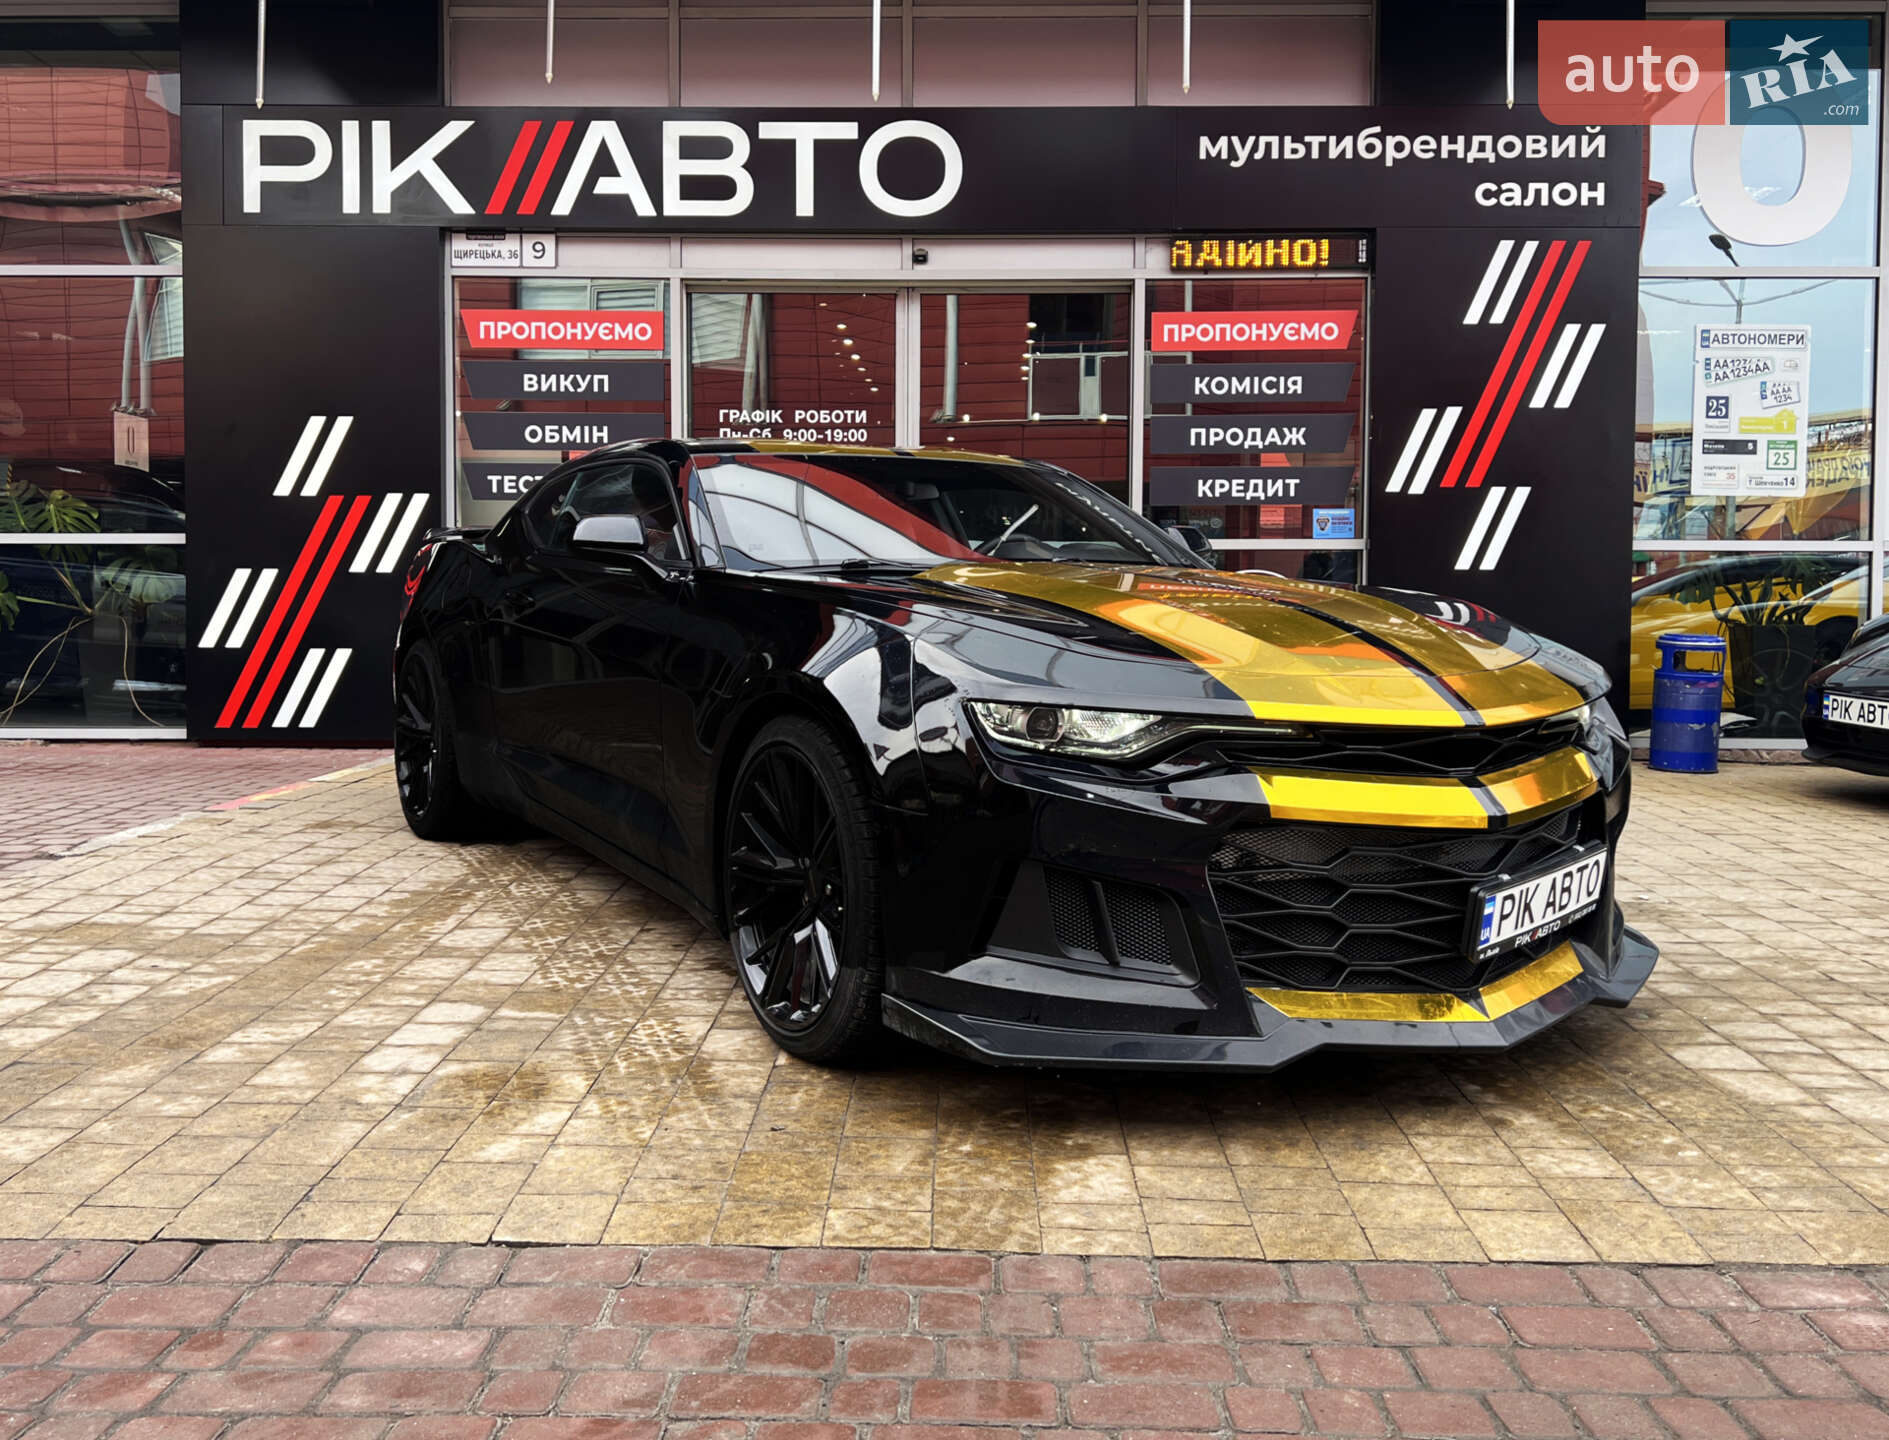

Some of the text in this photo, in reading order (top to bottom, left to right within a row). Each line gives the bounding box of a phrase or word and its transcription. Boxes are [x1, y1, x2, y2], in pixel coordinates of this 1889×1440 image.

[1198, 125, 1607, 168] мультибрендовий
[242, 119, 963, 218] РІК АВТО
[1474, 181, 1606, 207] салон
[507, 249, 519, 260] 36
[532, 241, 546, 259] 9
[478, 321, 653, 341] ПРОПОНУЄМО
[1162, 322, 1340, 342] ПРОПОНУЄМО
[1711, 333, 1805, 345] АВТОНОМЕРИ
[523, 373, 610, 393] ВИКУП
[1194, 375, 1303, 395] КОМІСІЯ
[719, 409, 867, 424] ГРАФІК РОБОТИ
[1708, 399, 1727, 417] 25
[524, 425, 609, 444] ОБМІН
[720, 427, 868, 442] Пн-Сб 9:00-19:00
[1190, 427, 1307, 449] ПРОДАЖ
[1773, 451, 1790, 467] 25
[1197, 478, 1300, 500] КРЕДИТ
[1784, 477, 1796, 486] 14
[1831, 698, 1889, 726] РІК АВТ
[1497, 858, 1600, 937] РІК АВТО
